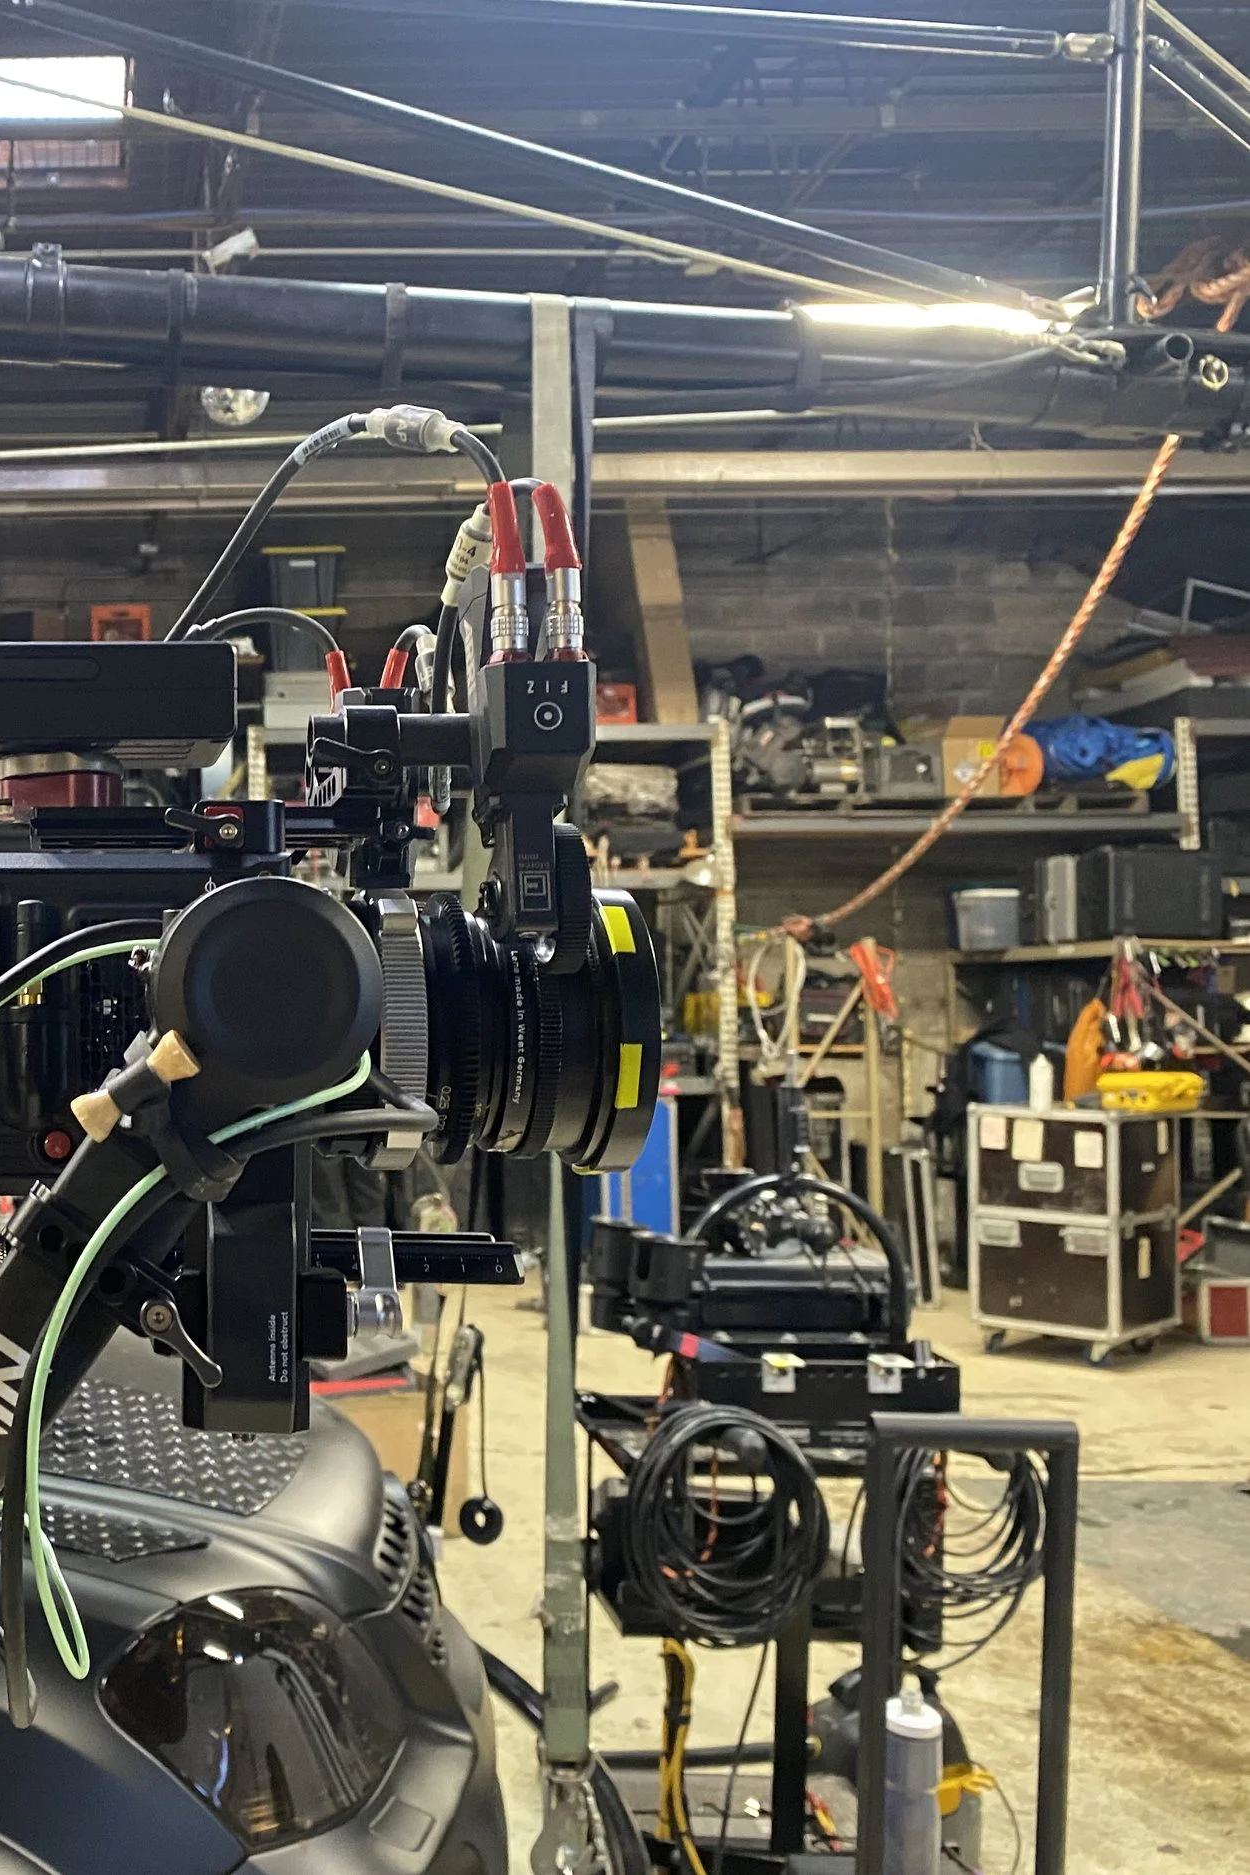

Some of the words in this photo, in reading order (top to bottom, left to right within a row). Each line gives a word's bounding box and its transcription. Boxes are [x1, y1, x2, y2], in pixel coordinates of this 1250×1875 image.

[514, 976, 525, 1007] made
[512, 1056, 526, 1104] Germany
[268, 1314, 276, 1342] inside
[280, 1311, 288, 1350] obstruct
[268, 1343, 276, 1382] Antenna
[280, 1369, 288, 1383] Do
